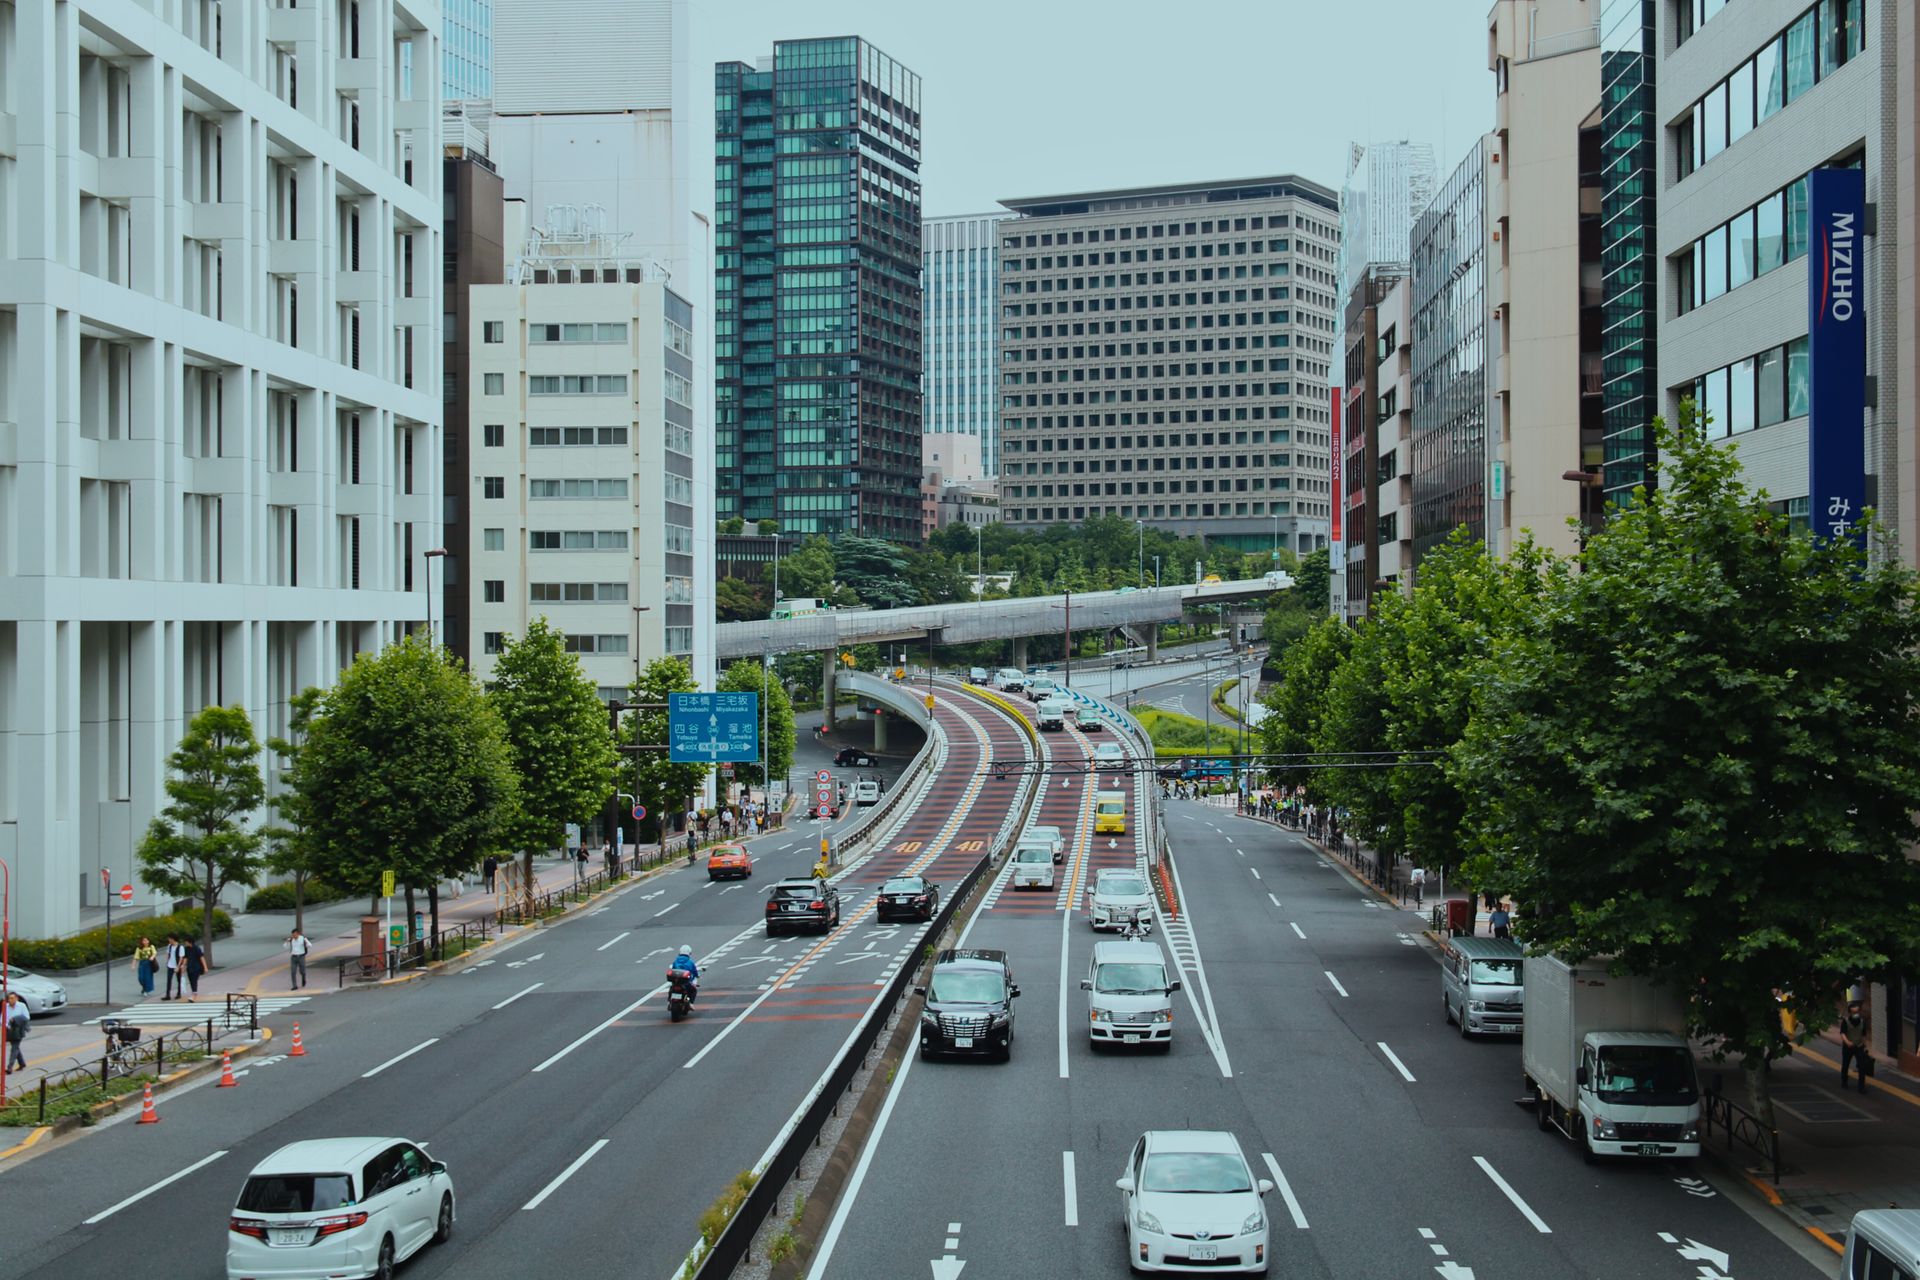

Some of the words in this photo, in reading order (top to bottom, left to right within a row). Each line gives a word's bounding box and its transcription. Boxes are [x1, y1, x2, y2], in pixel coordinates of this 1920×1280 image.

[1832, 212, 1854, 322] MIZUHO
[1332, 432, 1340, 480] 三井のリハウス
[679, 696, 710, 705] 日本橋
[716, 695, 748, 705] 三宅坂
[675, 724, 699, 733] 四谷
[729, 723, 752, 733] 溜池
[892, 841, 922, 853] 40
[954, 841, 985, 852] 40
